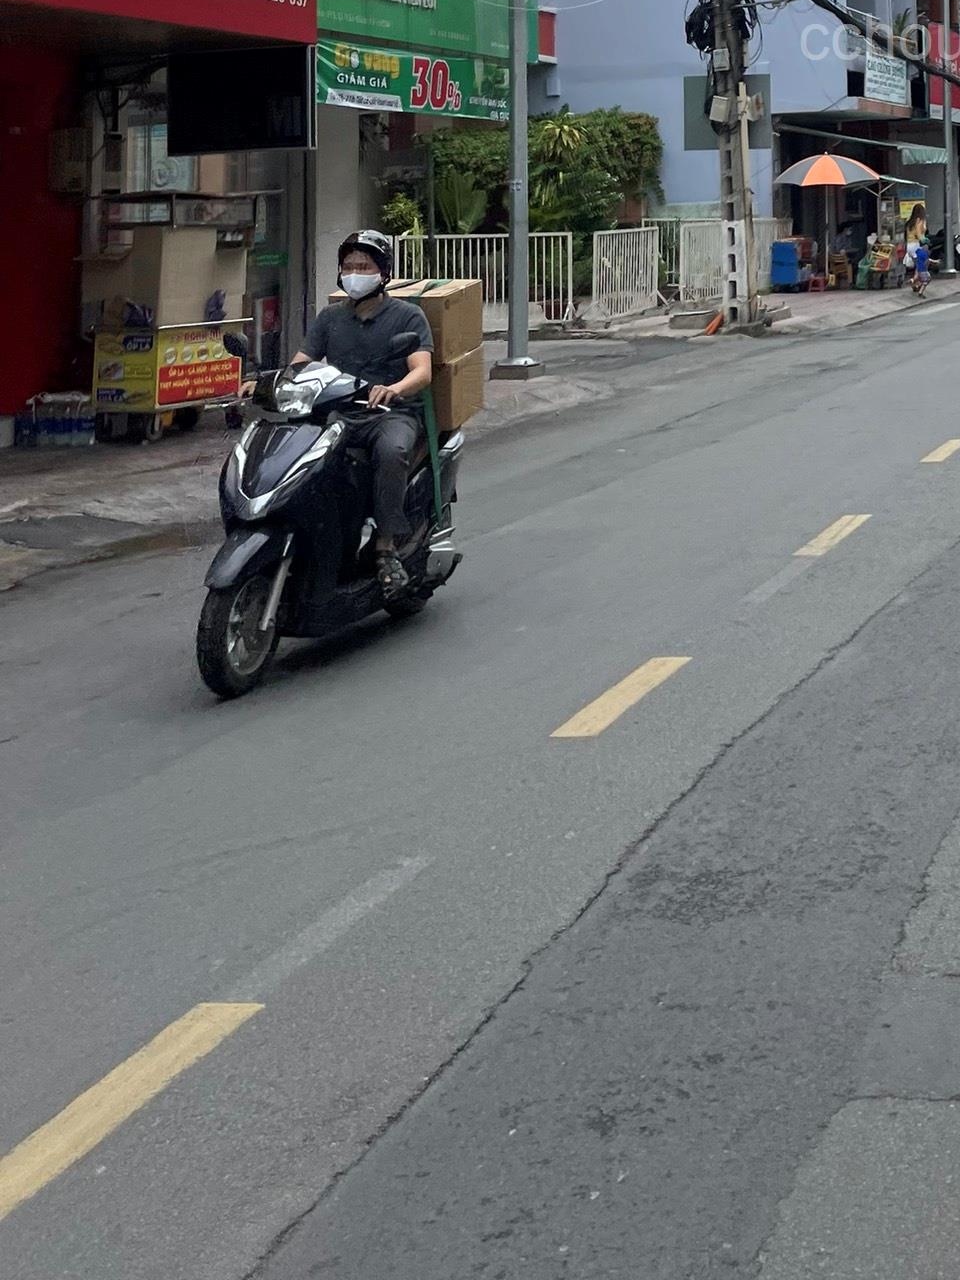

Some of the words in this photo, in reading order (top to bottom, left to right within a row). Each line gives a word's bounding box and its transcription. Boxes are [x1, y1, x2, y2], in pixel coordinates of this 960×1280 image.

[337, 72, 366, 86] GIẢM
[369, 76, 388, 89] GIÁ
[410, 55, 462, 111] 30%
